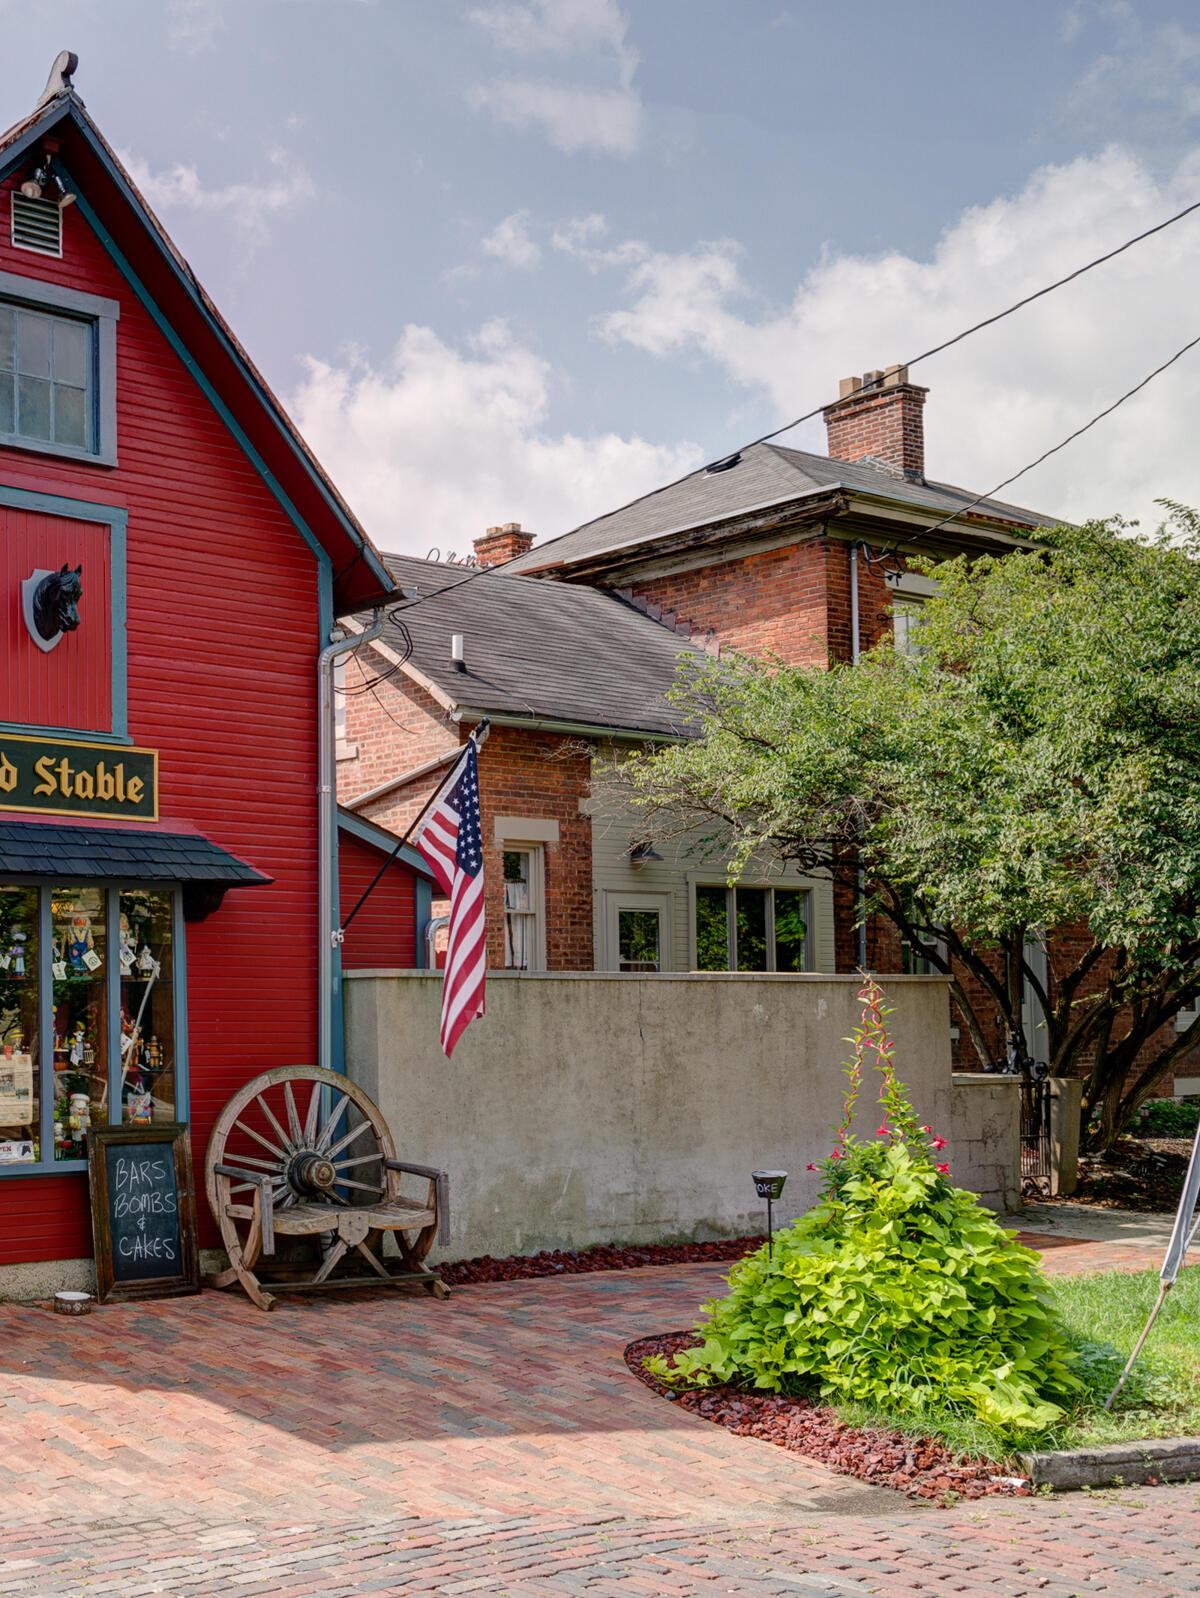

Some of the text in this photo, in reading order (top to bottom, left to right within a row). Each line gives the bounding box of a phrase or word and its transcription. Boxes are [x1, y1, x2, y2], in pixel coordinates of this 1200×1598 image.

[33, 754, 145, 803] Stable
[115, 1158, 166, 1193] BARS
[114, 1192, 177, 1219] BOMBS
[118, 1233, 175, 1262] CAKES
